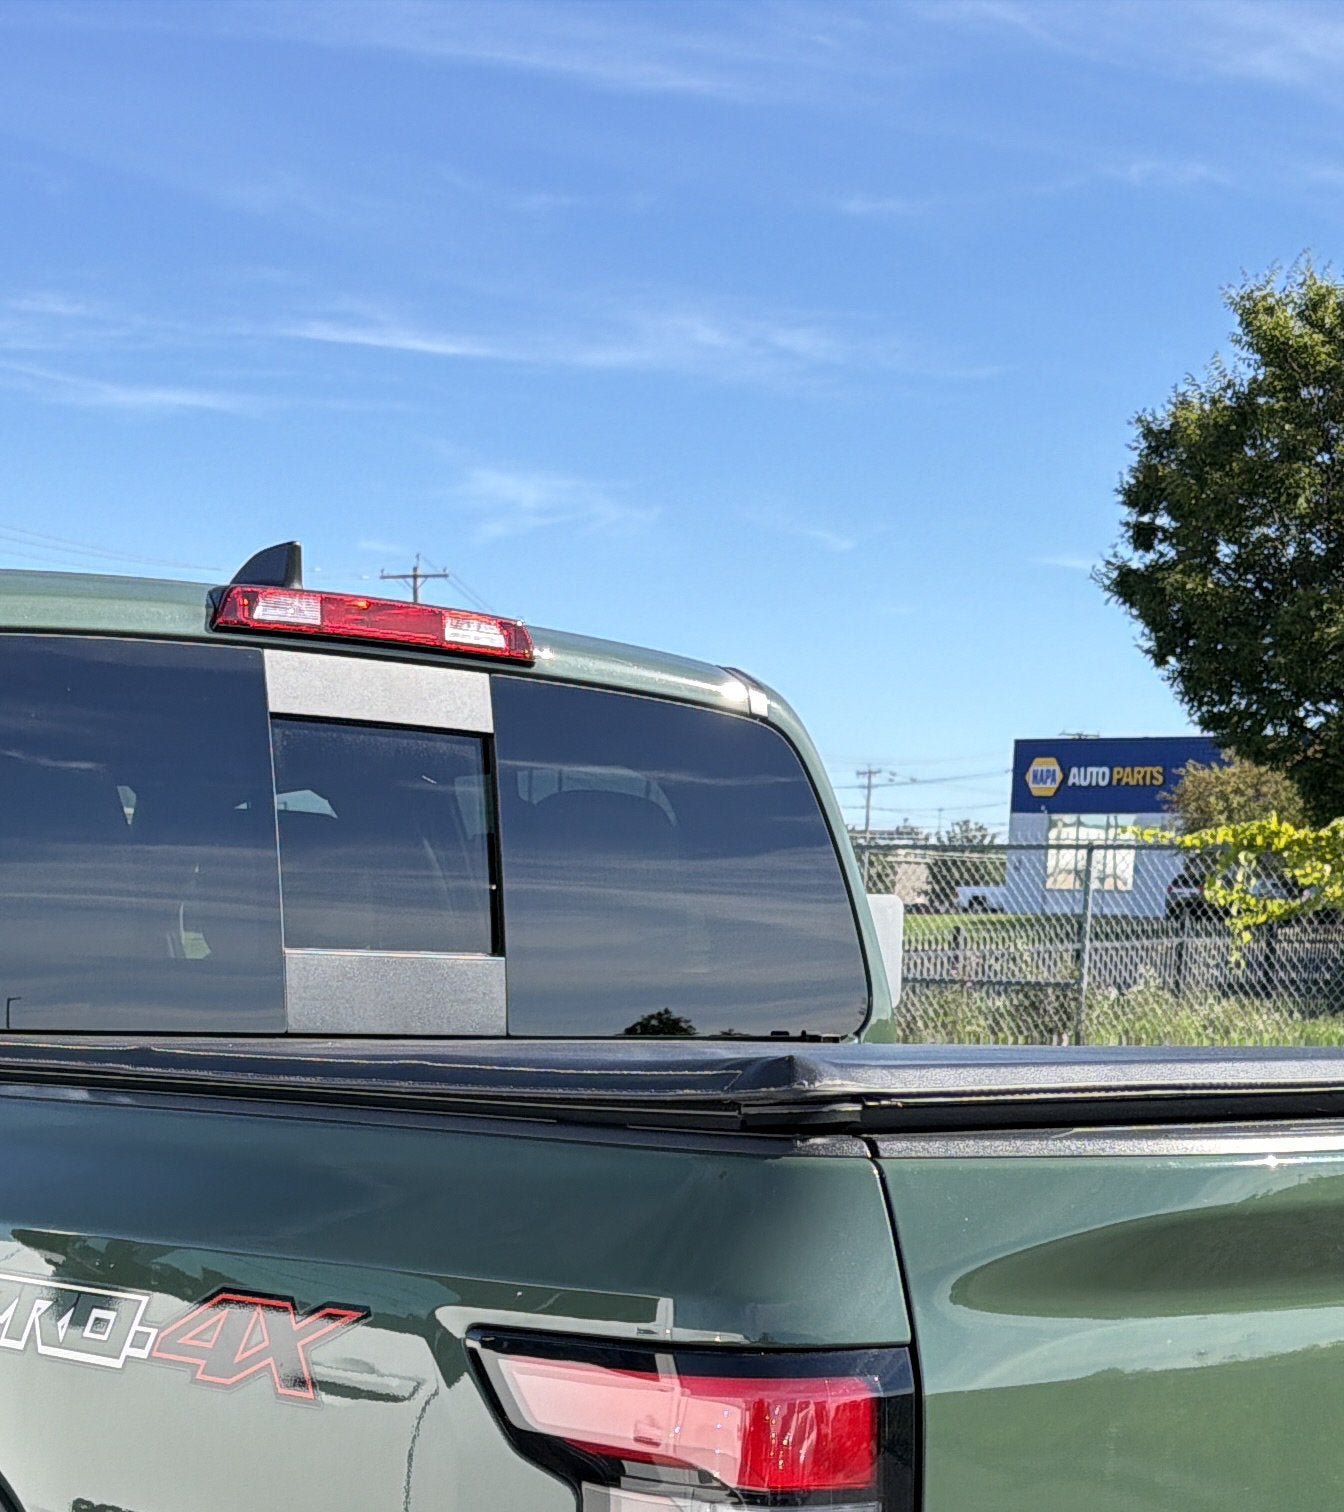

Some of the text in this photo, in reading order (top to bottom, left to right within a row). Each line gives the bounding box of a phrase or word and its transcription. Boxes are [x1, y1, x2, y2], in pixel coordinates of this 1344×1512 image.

[1031, 766, 1165, 787] NAPA AUTO PARTS
